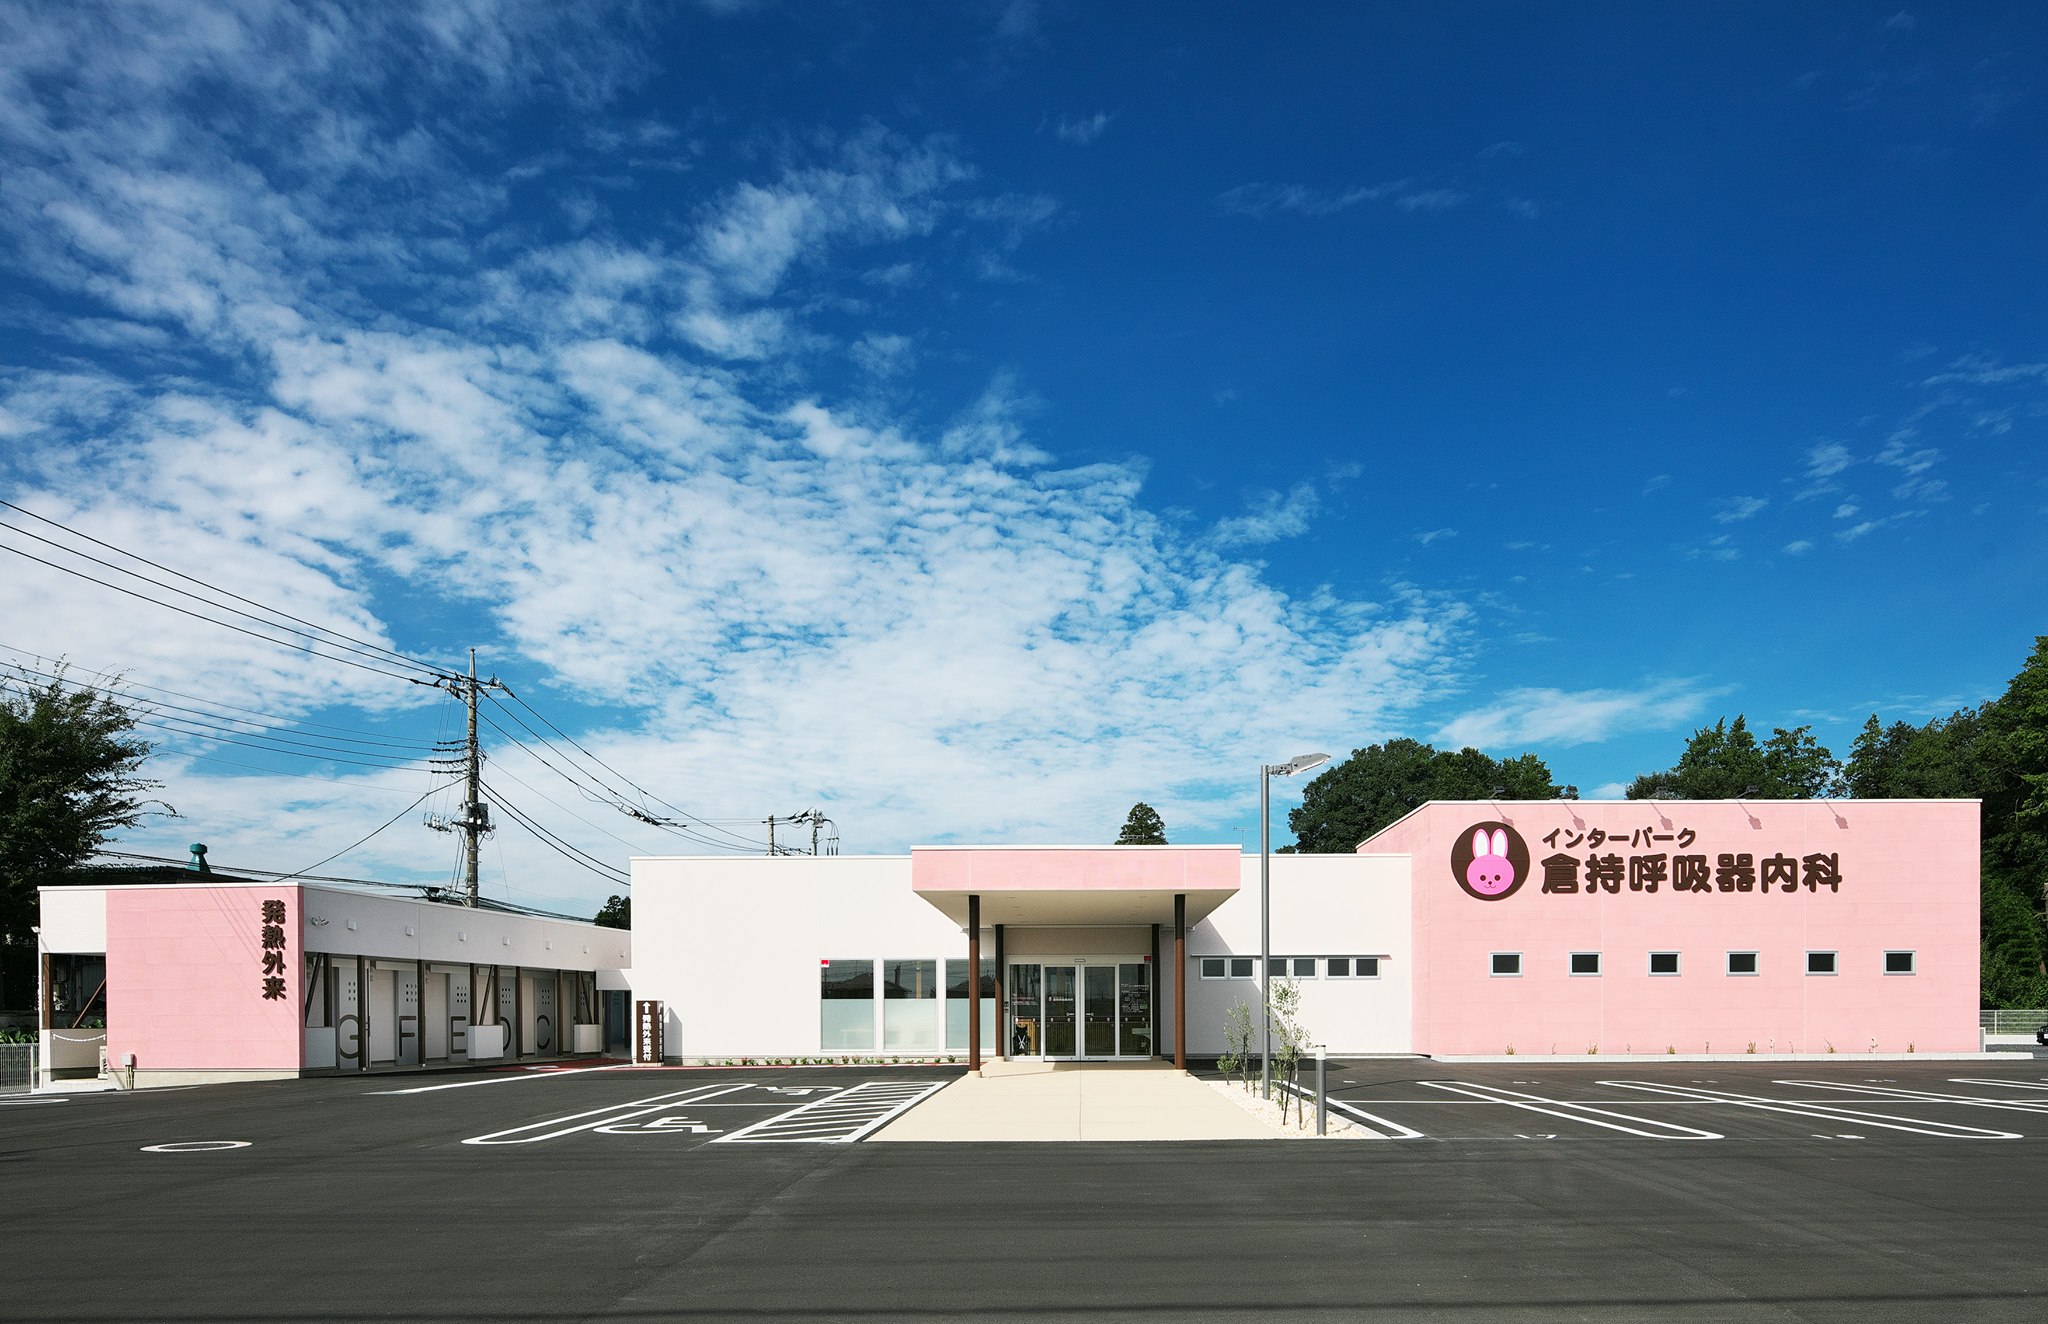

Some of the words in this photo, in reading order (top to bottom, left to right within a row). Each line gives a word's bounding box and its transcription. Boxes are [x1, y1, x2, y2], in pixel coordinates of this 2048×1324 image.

[1541, 827, 1696, 849] インターパーク
[1541, 852, 1843, 893] 倉持呼吸器内科
[262, 899, 287, 1001] 発熱外来
[399, 1016, 417, 1057] F
[450, 1016, 467, 1054] E
[536, 1014, 550, 1050] C
